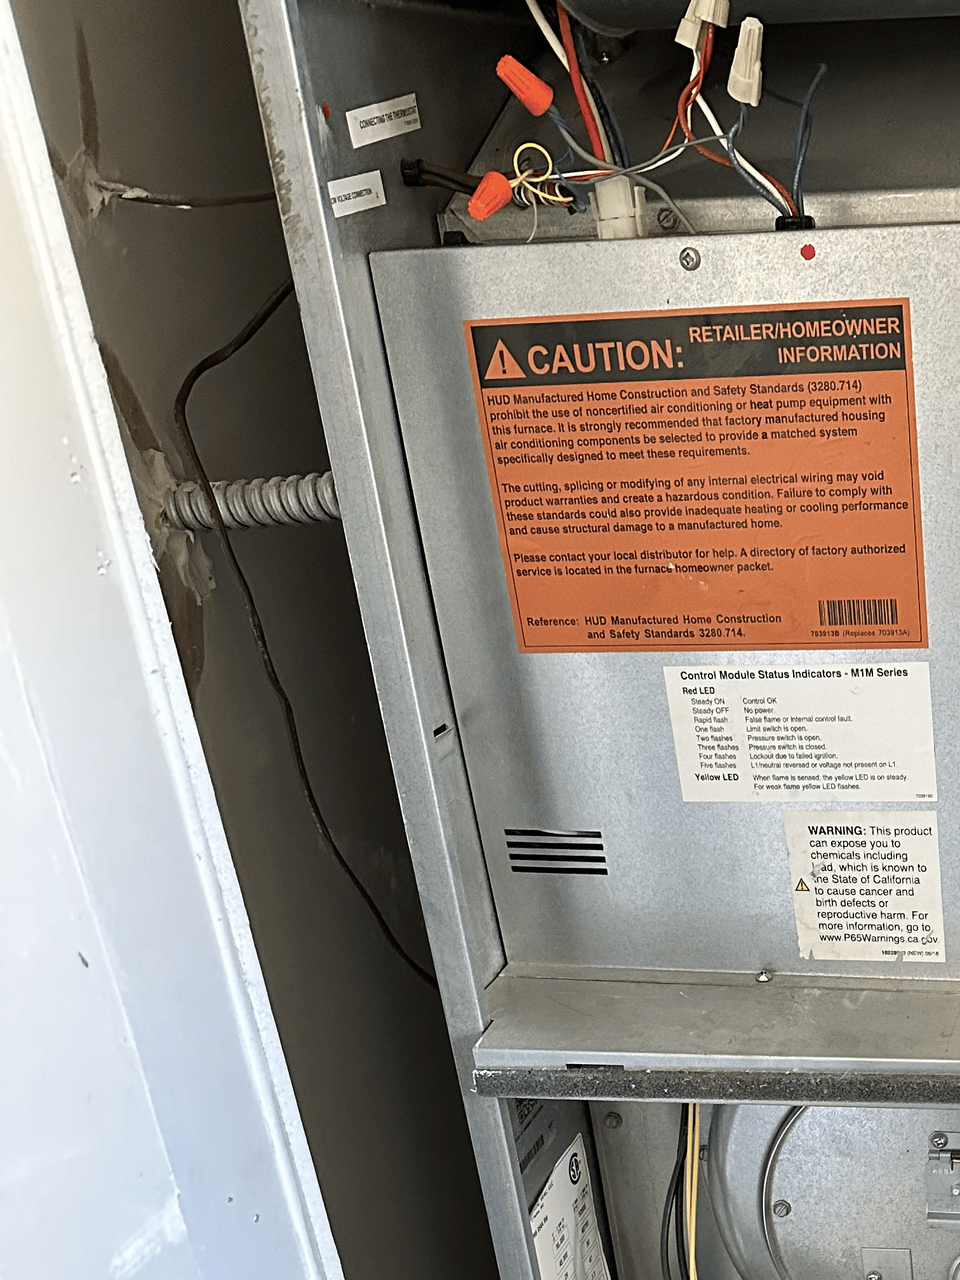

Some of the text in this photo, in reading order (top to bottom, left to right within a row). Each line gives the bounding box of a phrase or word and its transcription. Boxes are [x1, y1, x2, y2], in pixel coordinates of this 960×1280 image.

[688, 317, 901, 344] RETAILER/HOMEOWNER
[527, 338, 684, 375] CAUTION:
[777, 341, 901, 364] INFORMATION
[486, 379, 863, 407] HUD Manufactured Home Construction and Safety Standards (3280.714)
[489, 393, 892, 424] prohibit the use of noncertified air conditioning or heat pump equipment with
[491, 409, 886, 436] this furnace. It is strongly recommended that factory manufactured housing
[496, 445, 751, 467] specifically designed to meet these requirements.
[526, 613, 782, 627] Reference: HUD Manufactured Home Construction
[587, 627, 746, 641] and Safety Standards 3280.714.
[679, 670, 717, 681] Control
[718, 669, 756, 680] Module
[757, 669, 790, 680] Status
[791, 669, 842, 679] Indicators
[850, 667, 874, 678] M1M
[876, 667, 909, 678] Series
[681, 686, 716, 695] Red LED
[694, 772, 740, 782] Yellow LED
[807, 825, 933, 838] WARNING: This product
[808, 839, 902, 851] can expose you to
[810, 850, 909, 863] chemicals including
[838, 862, 868, 873] which
[870, 862, 880, 873] is
[881, 862, 915, 873] known
[916, 863, 928, 873] to
[831, 873, 858, 885] State
[860, 874, 871, 885] of
[872, 874, 921, 885] California
[813, 886, 915, 897] to cause cancer and
[815, 897, 889, 909] birth defects or
[816, 909, 929, 921] reproductive harm. For
[818, 921, 933, 934] more information, go to
